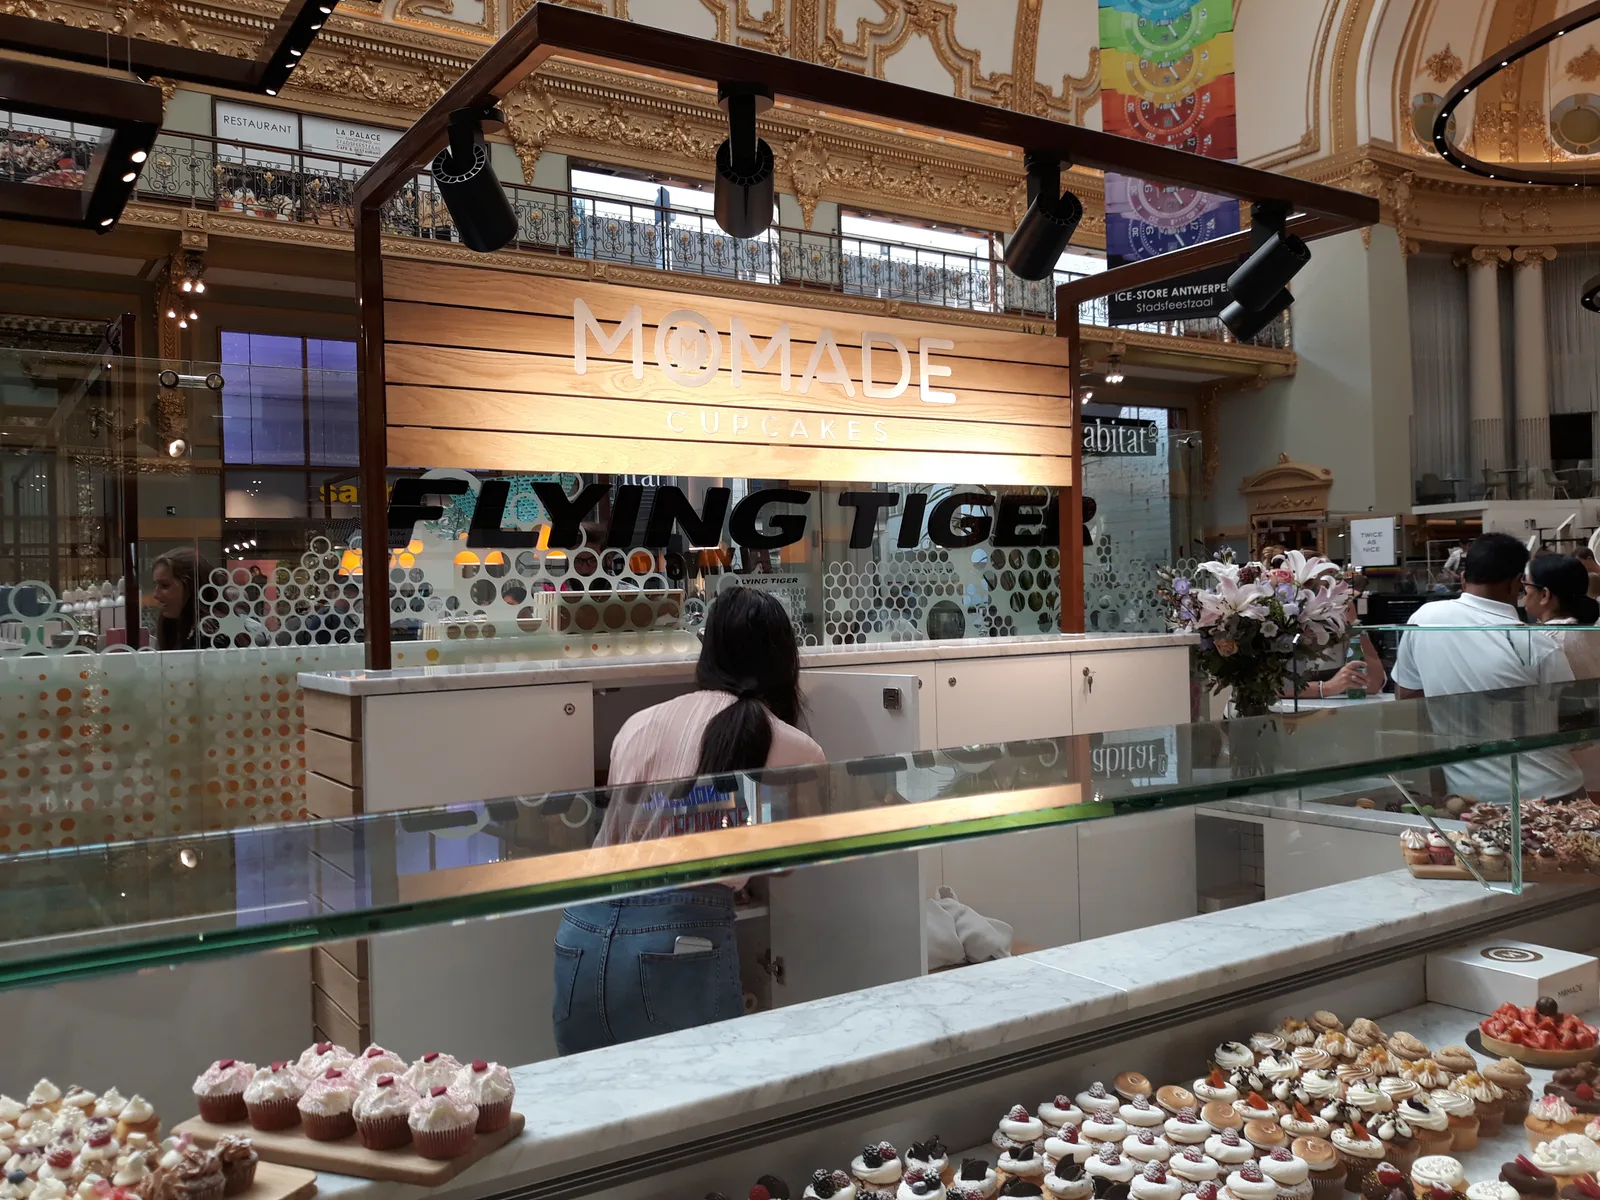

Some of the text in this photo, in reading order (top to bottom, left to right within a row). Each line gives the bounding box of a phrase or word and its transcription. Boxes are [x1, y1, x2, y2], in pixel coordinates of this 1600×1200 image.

[223, 115, 292, 134] RESTAURANT
[335, 128, 381, 142] LA PALACE
[1115, 283, 1229, 302] ICE-STORE ANTWERPE
[1136, 297, 1213, 313] Stadsfeestzaal
[573, 298, 957, 405] MOMADE
[666, 410, 888, 442] CUPCAKES
[1081, 418, 1148, 454] abitat
[386, 478, 1096, 550] FLYING TIGER
